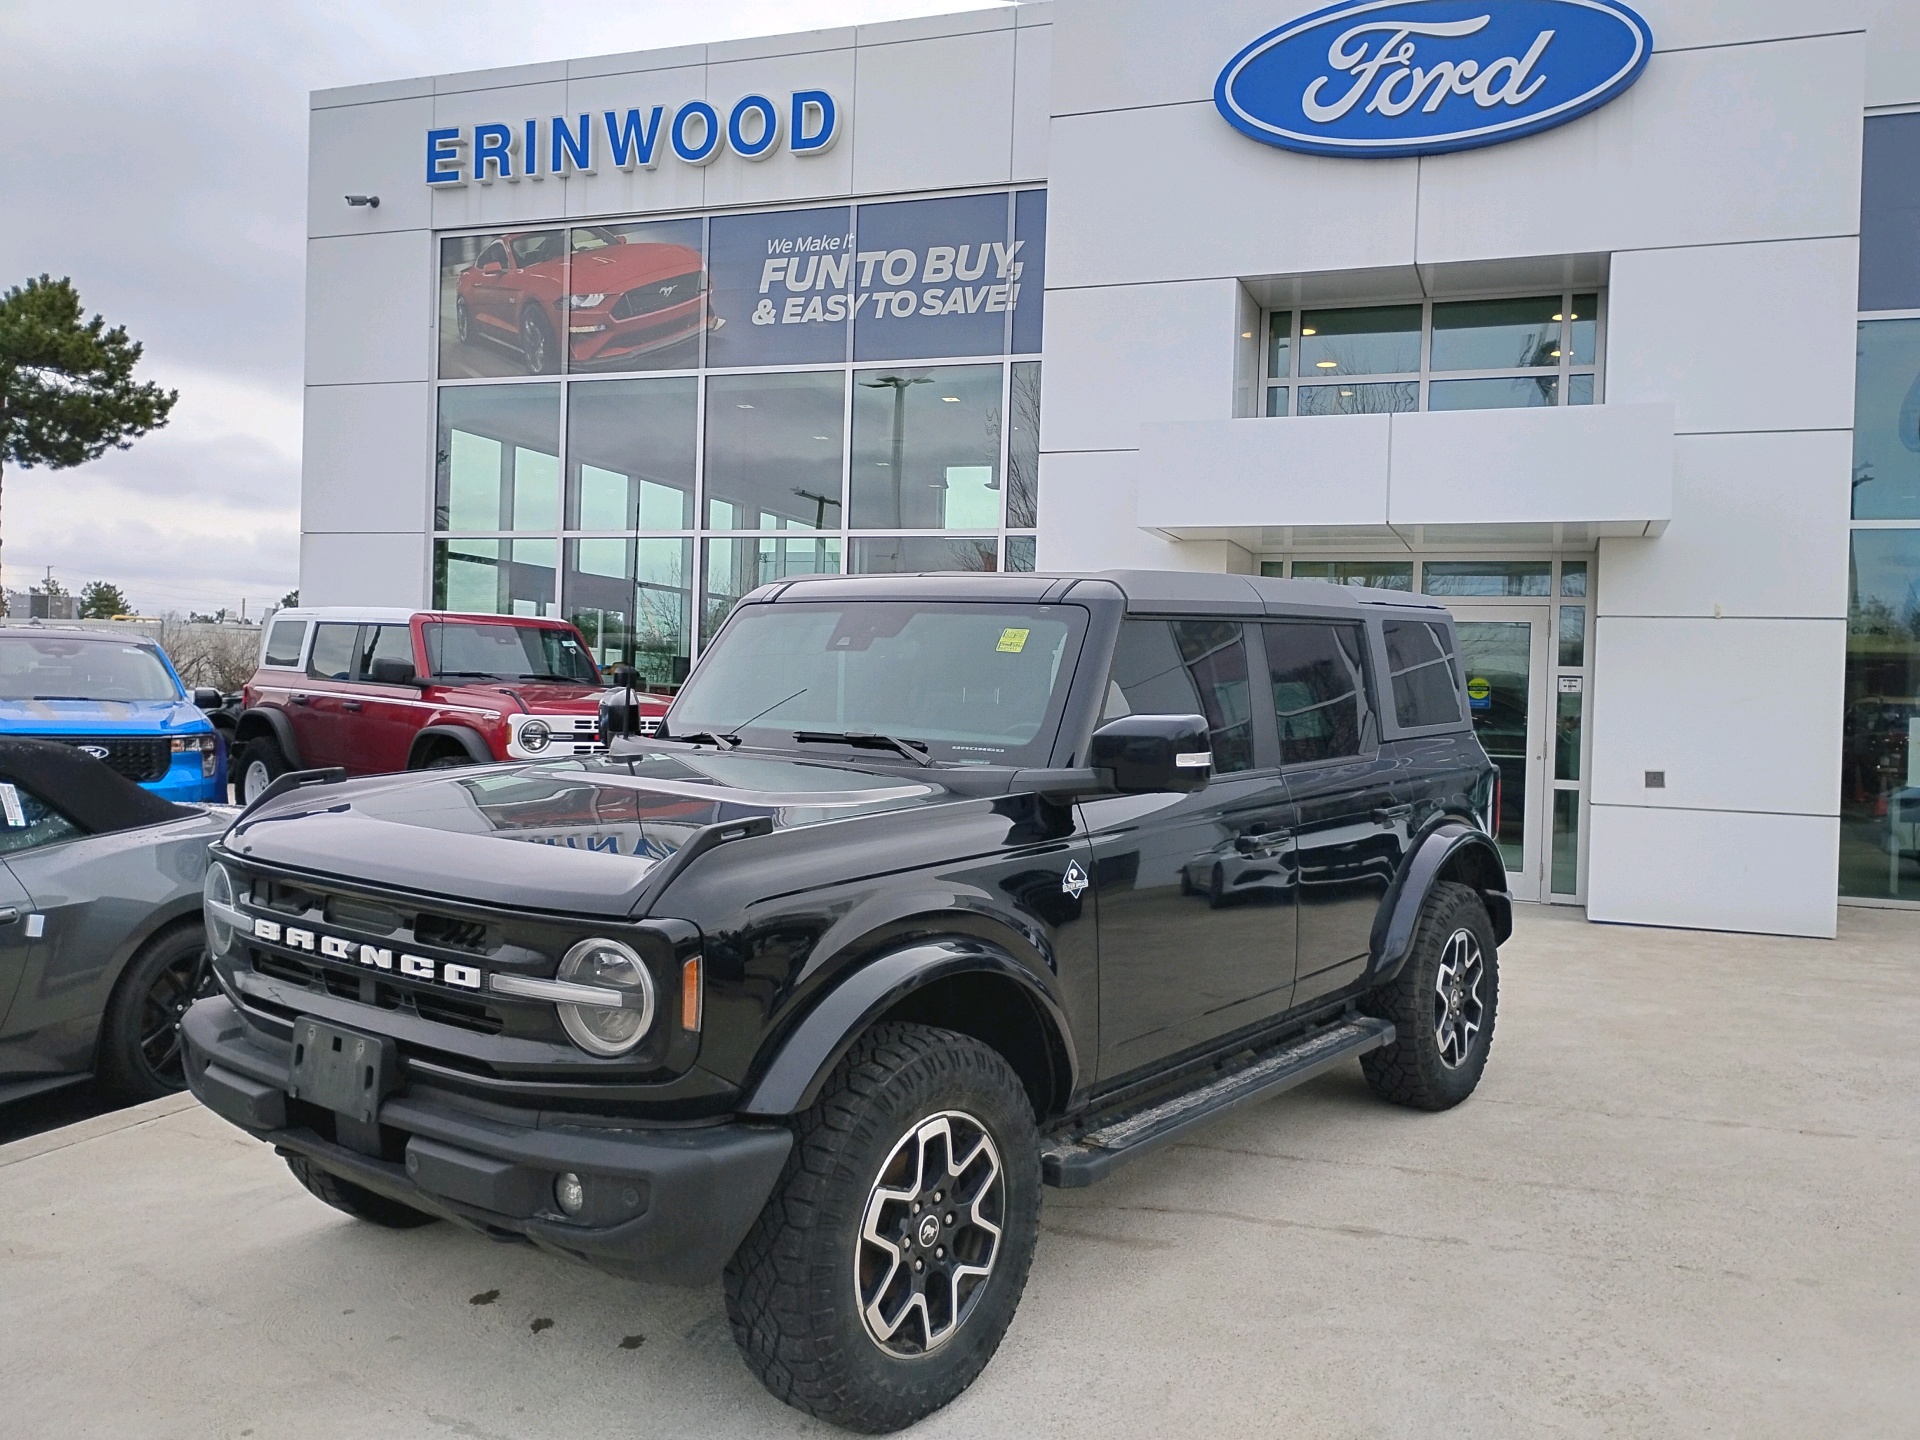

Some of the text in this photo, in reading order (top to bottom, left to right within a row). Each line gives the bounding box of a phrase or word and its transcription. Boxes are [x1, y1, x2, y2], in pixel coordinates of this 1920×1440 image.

[1302, 14, 1556, 123] Ford
[426, 89, 840, 187] ERINWOOD
[759, 253, 851, 294] FUN
[857, 248, 917, 288] TO
[767, 232, 855, 255] We Make It
[751, 283, 1021, 326] & EASY TO SAVE!
[253, 917, 482, 990] BRONCO
